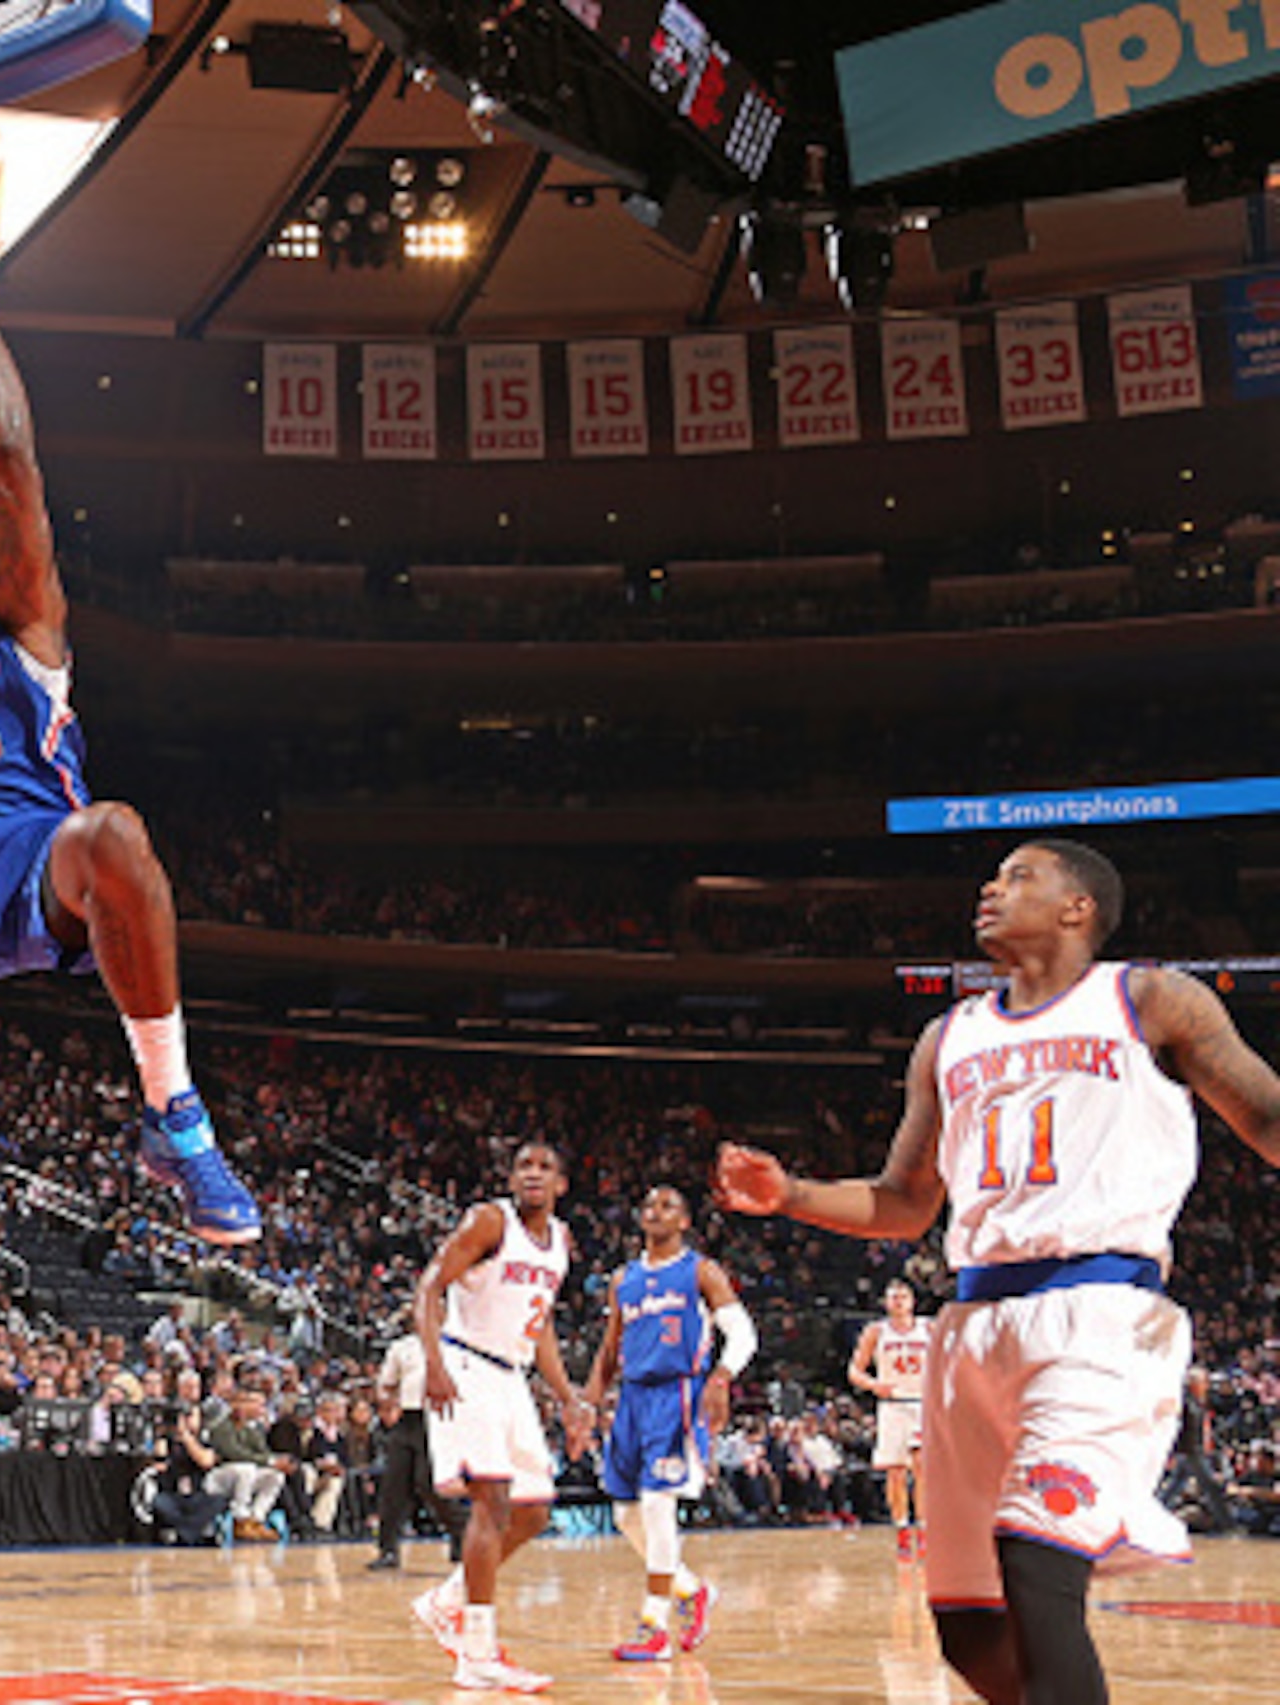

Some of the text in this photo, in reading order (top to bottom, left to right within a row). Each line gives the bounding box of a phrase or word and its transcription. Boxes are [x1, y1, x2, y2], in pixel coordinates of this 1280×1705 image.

[1006, 339, 1072, 387] 33
[1114, 322, 1195, 373] 613
[278, 376, 323, 418] 10
[580, 373, 632, 417] 15
[686, 368, 736, 415] 19
[785, 361, 849, 407] 22
[891, 353, 955, 399] 24
[376, 378, 423, 421] 12
[482, 378, 529, 421] 15
[943, 794, 1179, 829] ZTE Smartphones
[1017, 1033, 1120, 1082] YORK
[977, 1096, 1058, 1189] 11
[660, 1315, 682, 1345] 3
